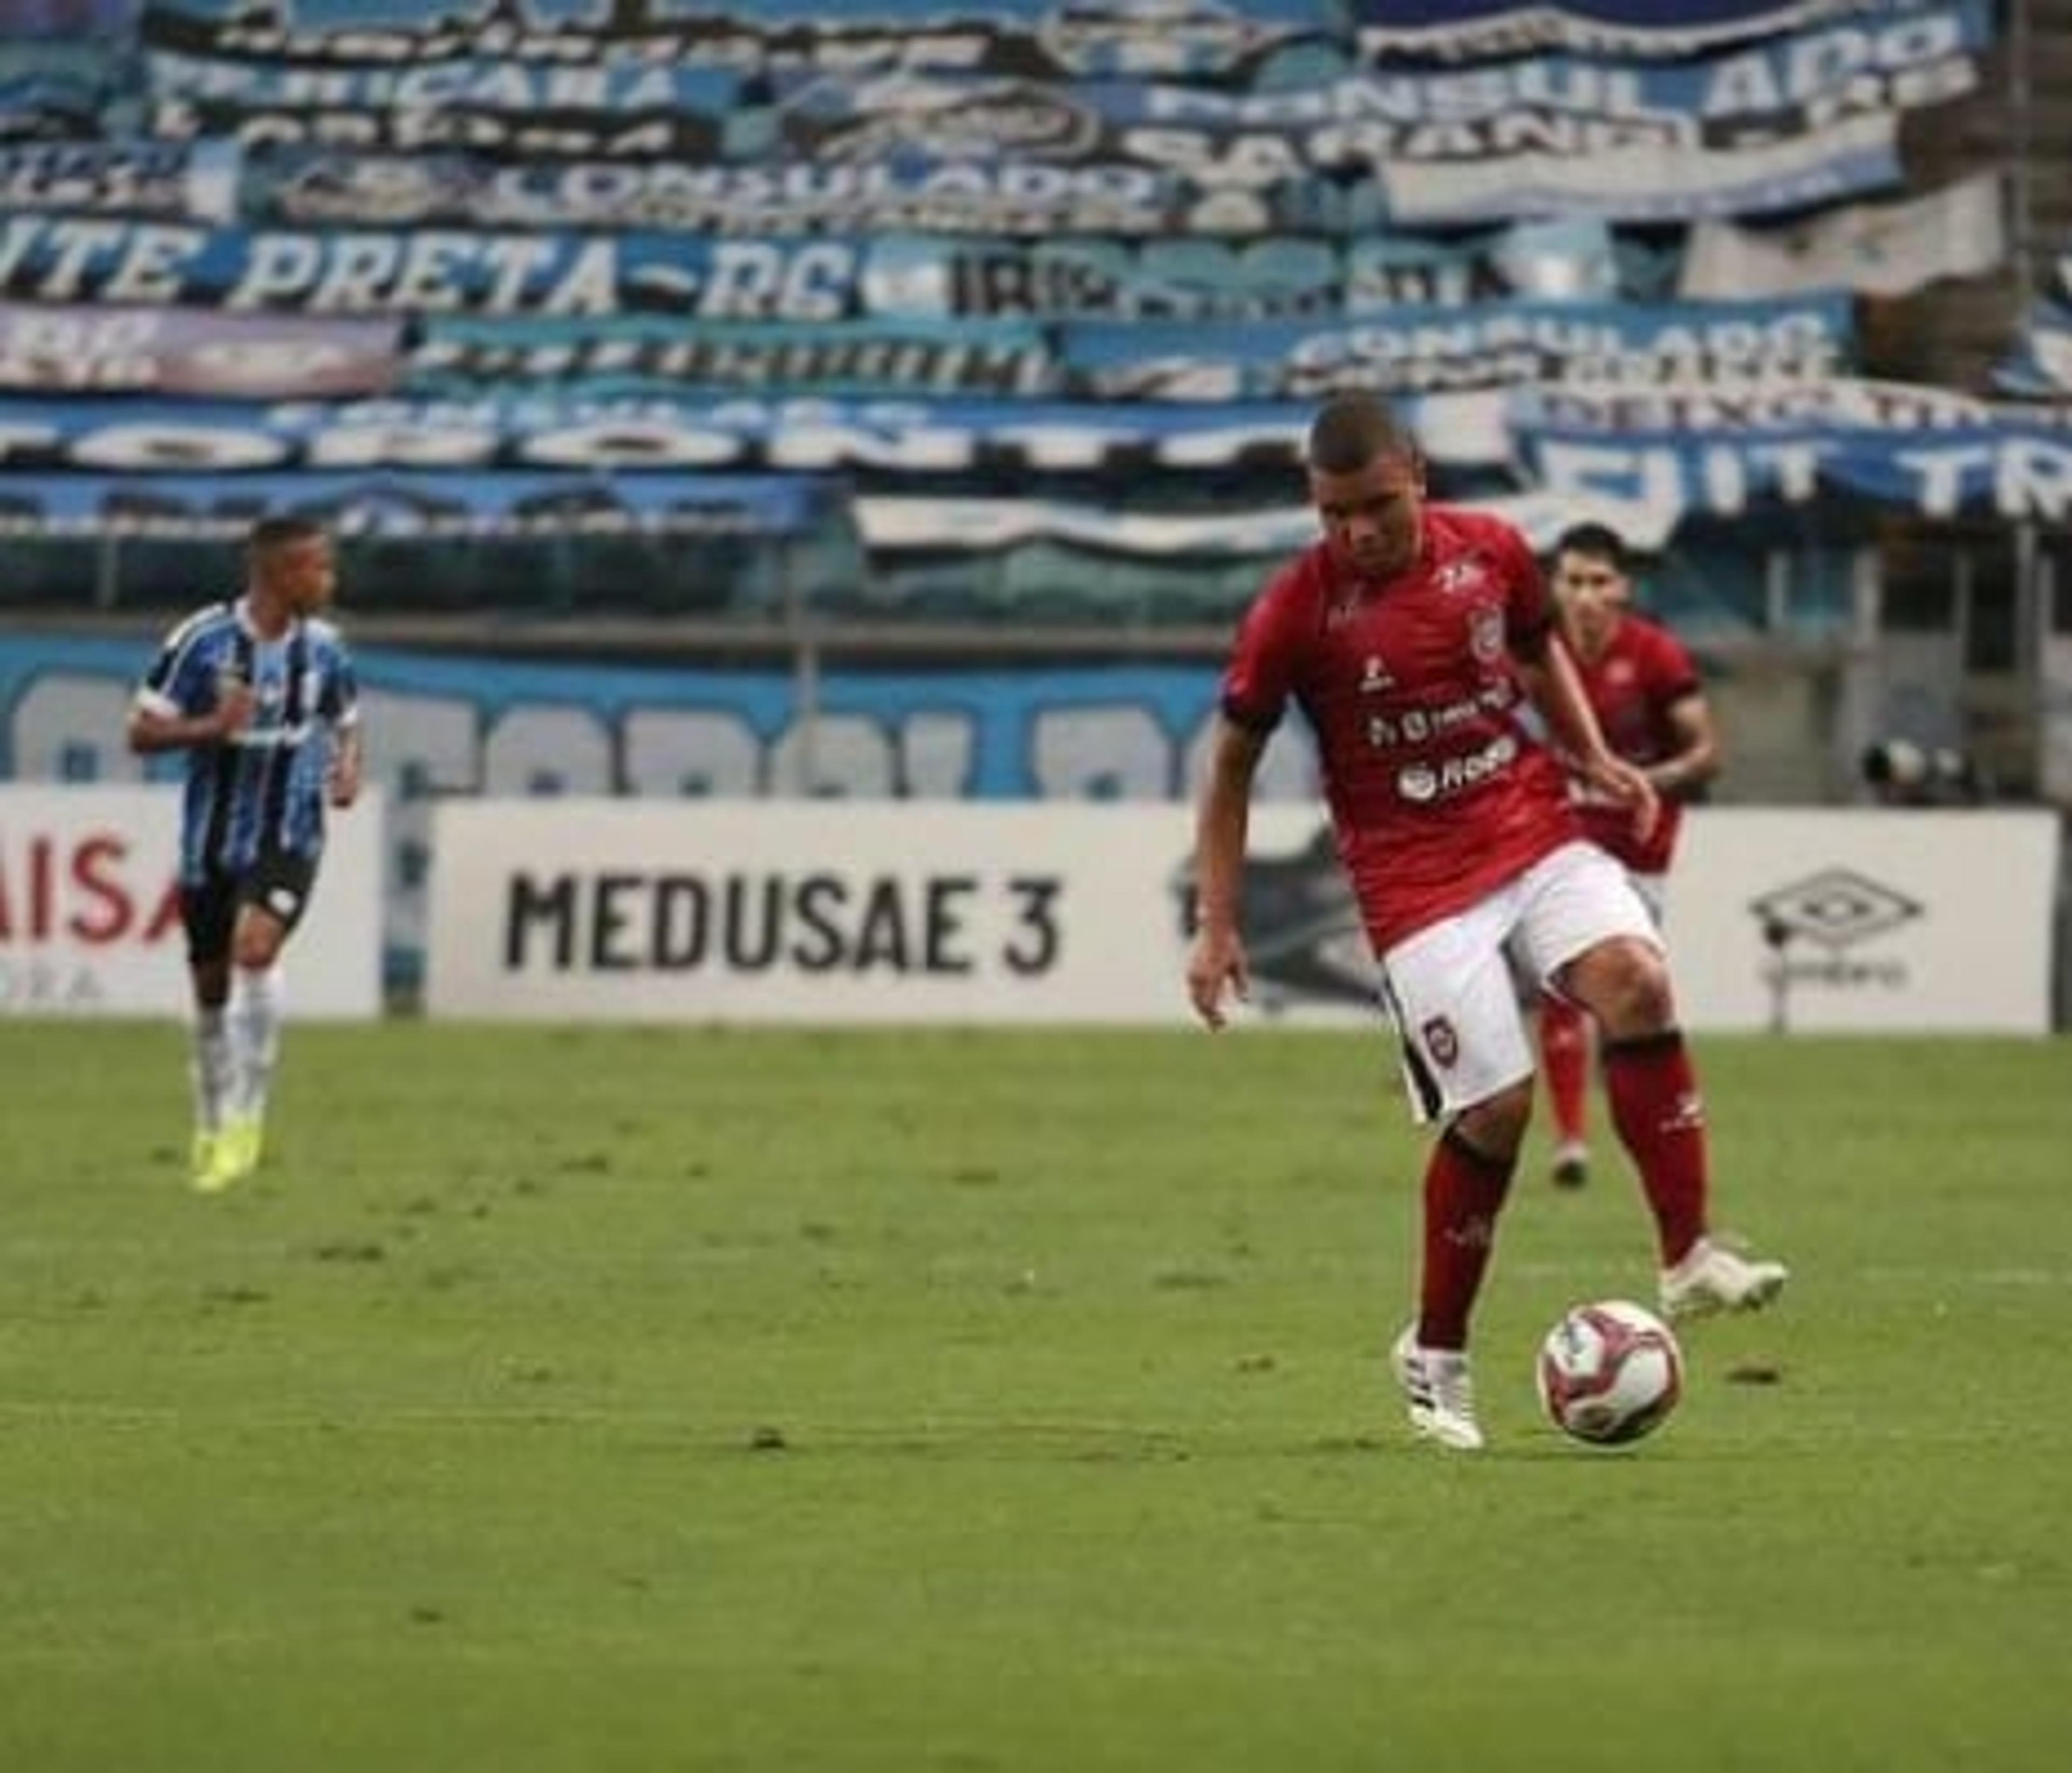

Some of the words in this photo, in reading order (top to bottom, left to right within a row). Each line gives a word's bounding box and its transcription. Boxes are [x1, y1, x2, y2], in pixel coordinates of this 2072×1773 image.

[494, 163, 1156, 202] CONSULADO
[506, 874, 978, 976] MEDUSAE
[1005, 878, 1061, 974] 3
